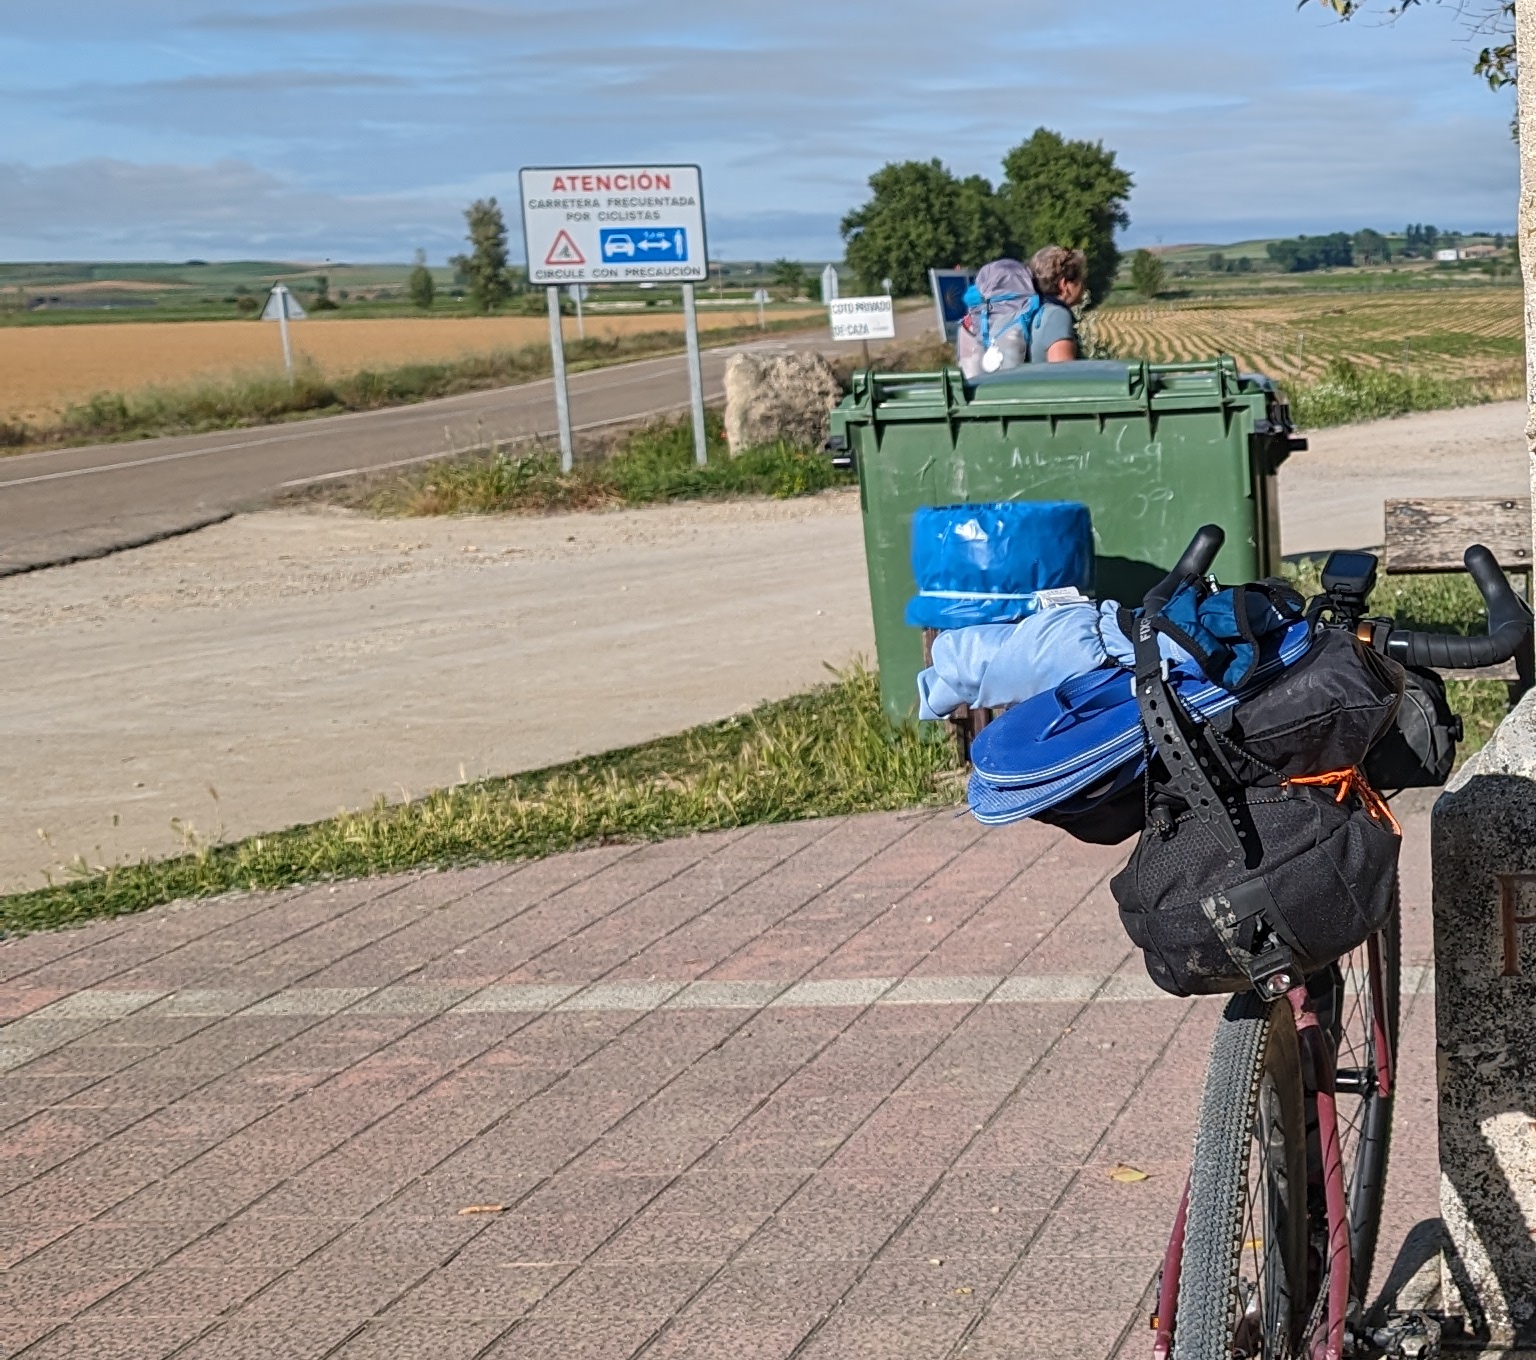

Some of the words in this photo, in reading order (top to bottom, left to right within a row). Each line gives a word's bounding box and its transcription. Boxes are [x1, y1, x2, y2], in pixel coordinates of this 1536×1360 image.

[552, 170, 671, 193] ATENCIÓN
[528, 197, 601, 210] CARRETERA
[607, 195, 696, 208] FRECUENTADA
[566, 211, 591, 222] POR
[598, 210, 661, 222] CICLISTAS
[535, 268, 585, 280] CIRCULE
[592, 267, 619, 278] CON
[832, 303, 854, 315] COTO
[855, 300, 891, 314] PRIVADO
[833, 324, 845, 337] DE
[847, 322, 870, 336] CAZA
